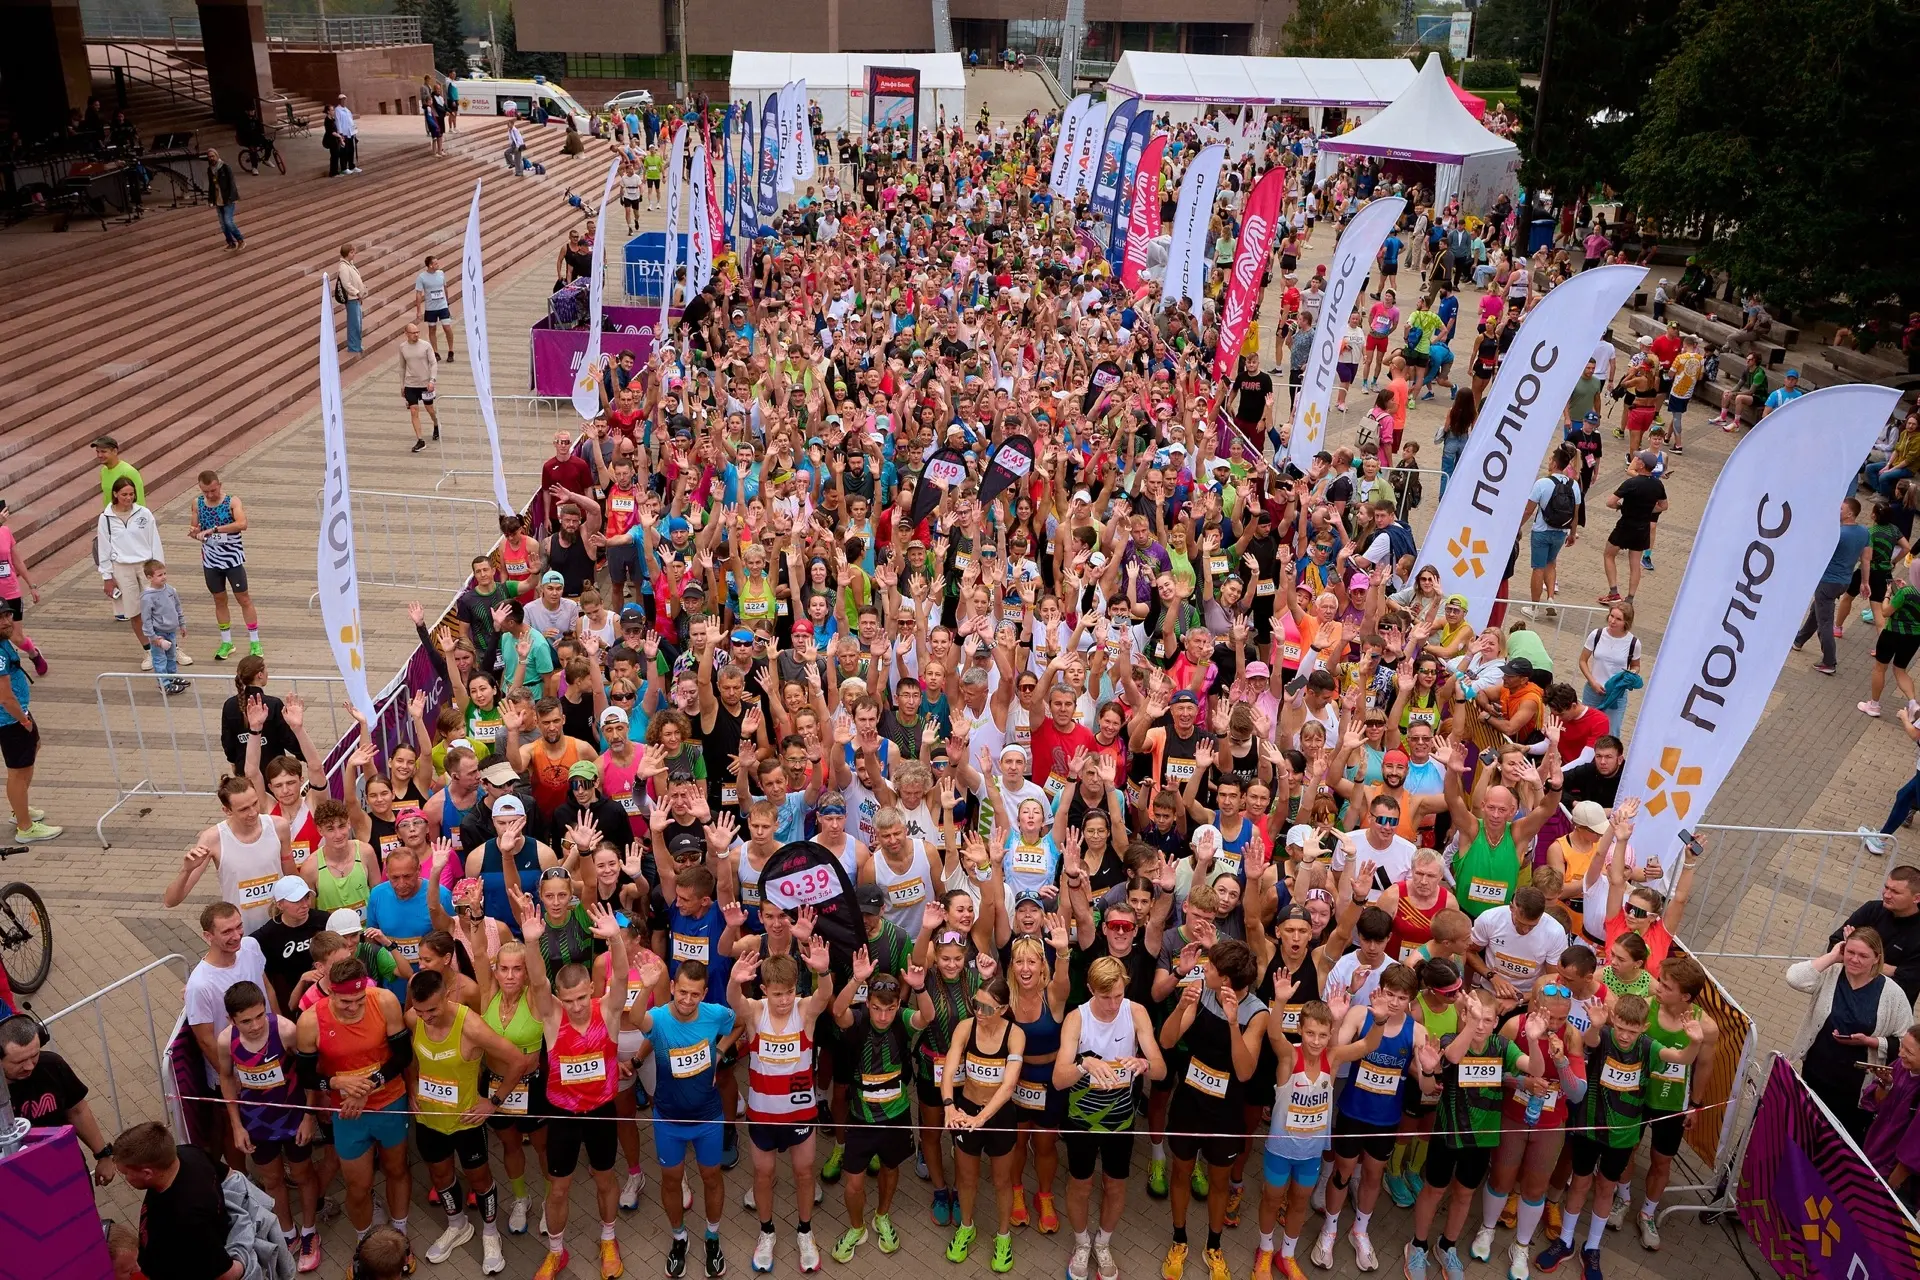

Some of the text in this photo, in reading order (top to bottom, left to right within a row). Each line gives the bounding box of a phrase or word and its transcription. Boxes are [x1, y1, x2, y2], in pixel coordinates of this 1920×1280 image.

[1150, 176, 1158, 236] МАРАФОН
[1182, 241, 1192, 299] MODA
[1316, 252, 1357, 392] ПОЛЮС
[1471, 340, 1559, 516] ПОЛЮС
[1002, 448, 1024, 468] 0:49
[933, 462, 958, 478] 0:49
[1211, 560, 1225, 568] 795
[1680, 492, 1793, 733] ПОЛЮС
[424, 676, 444, 714] ЛЮС
[1171, 764, 1194, 775] 1869
[292, 849, 304, 859] 09
[1018, 852, 1042, 864] 1312
[780, 868, 830, 896] 0:39
[245, 882, 275, 898] 2017
[893, 886, 920, 900] 1735
[1474, 884, 1502, 896] 1785
[397, 945, 418, 955] 961
[678, 942, 703, 956] 1787
[1500, 958, 1529, 976] 1888
[1282, 1012, 1300, 1024] 791
[764, 1042, 796, 1054] 1790
[676, 1050, 706, 1068] 1938
[566, 1060, 599, 1075] 2019
[971, 1063, 1000, 1078] 1661
[1464, 1066, 1496, 1076] 1789
[1664, 1064, 1680, 1074] 75
[244, 1070, 277, 1082] 1804
[1192, 1068, 1222, 1088] 1701
[1363, 1072, 1394, 1086] 1814
[1608, 1068, 1637, 1082] 1793
[424, 1081, 452, 1096] 1736
[1014, 1087, 1041, 1100] 1600
[1291, 1091, 1328, 1106] RUSSIA
[1293, 1112, 1323, 1124] 1715
